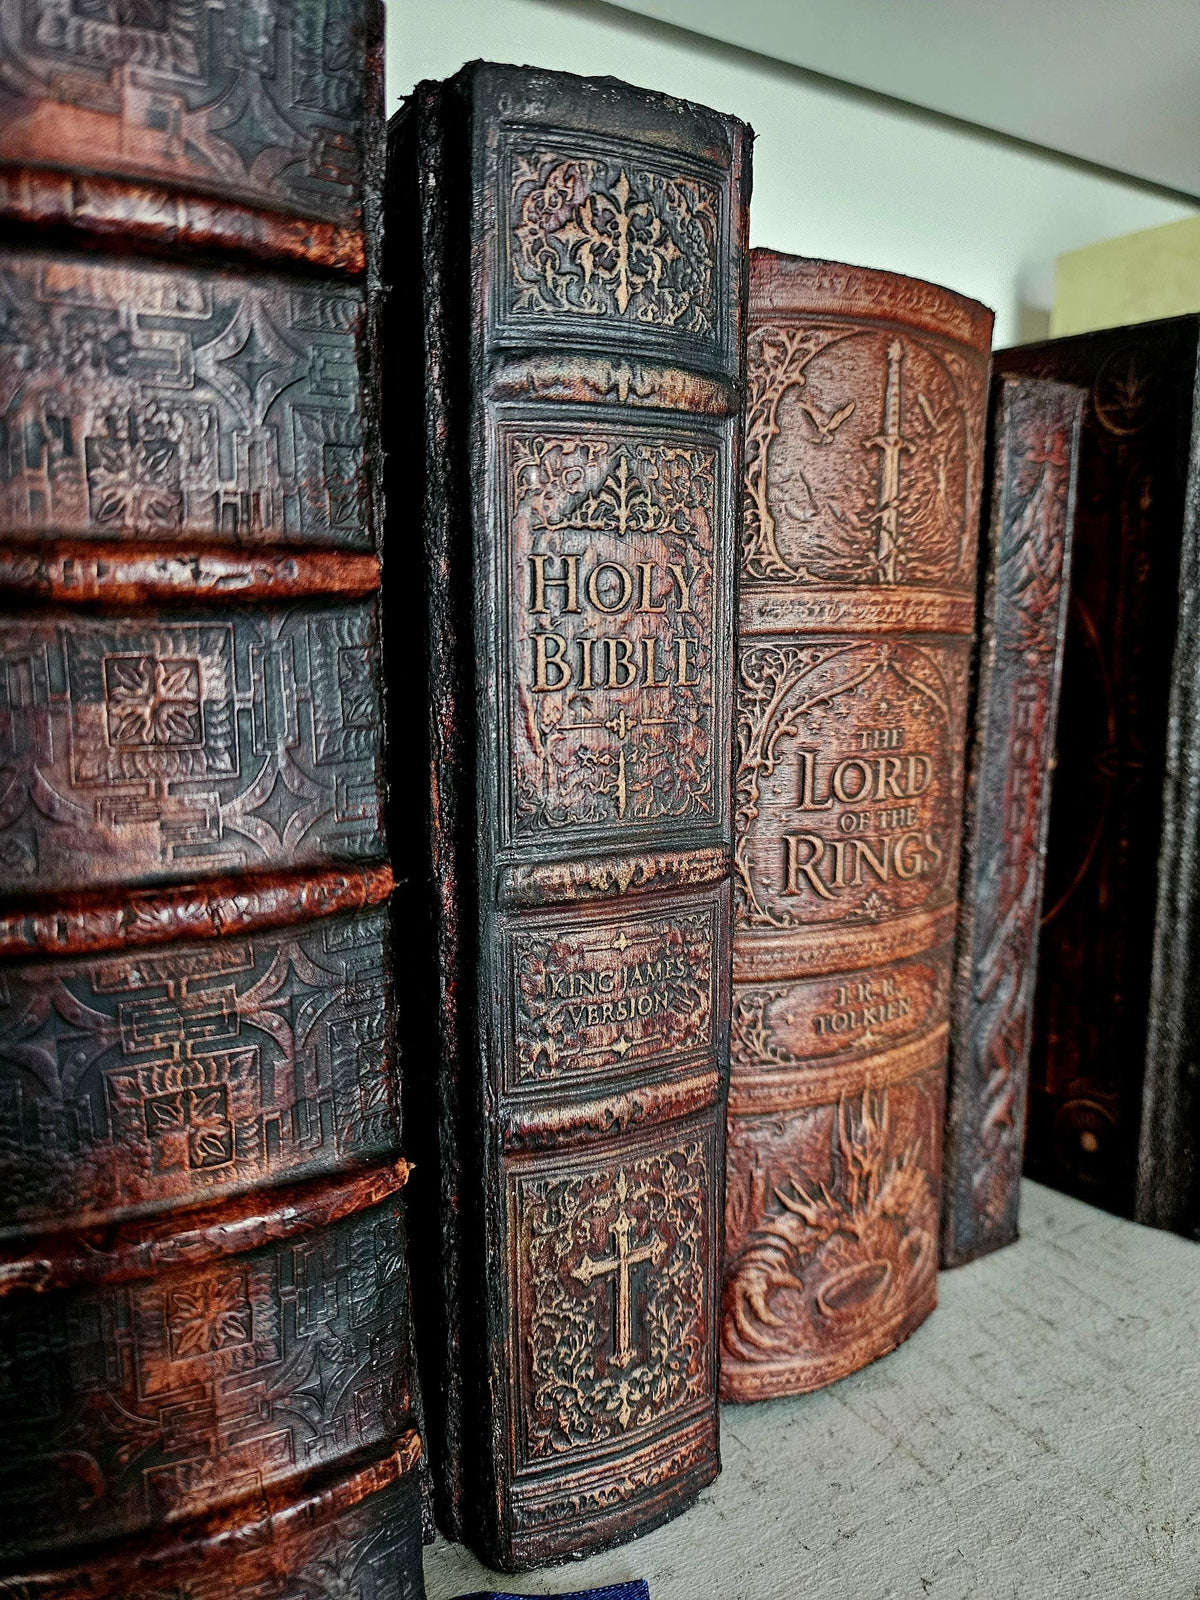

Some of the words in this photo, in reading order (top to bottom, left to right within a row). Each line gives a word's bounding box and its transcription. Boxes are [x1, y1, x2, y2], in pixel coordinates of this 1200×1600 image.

[528, 553, 701, 614] HOLY
[530, 631, 701, 692] BIBLE
[858, 728, 904, 750] THE
[797, 751, 933, 812] LORD
[840, 811, 871, 833] OF
[878, 807, 919, 829] THE
[779, 829, 945, 900] RINGS
[549, 969, 615, 999] KING
[621, 956, 688, 992] JAMES
[566, 990, 669, 1029] VERSION
[813, 997, 912, 1035] TOLKIEN
